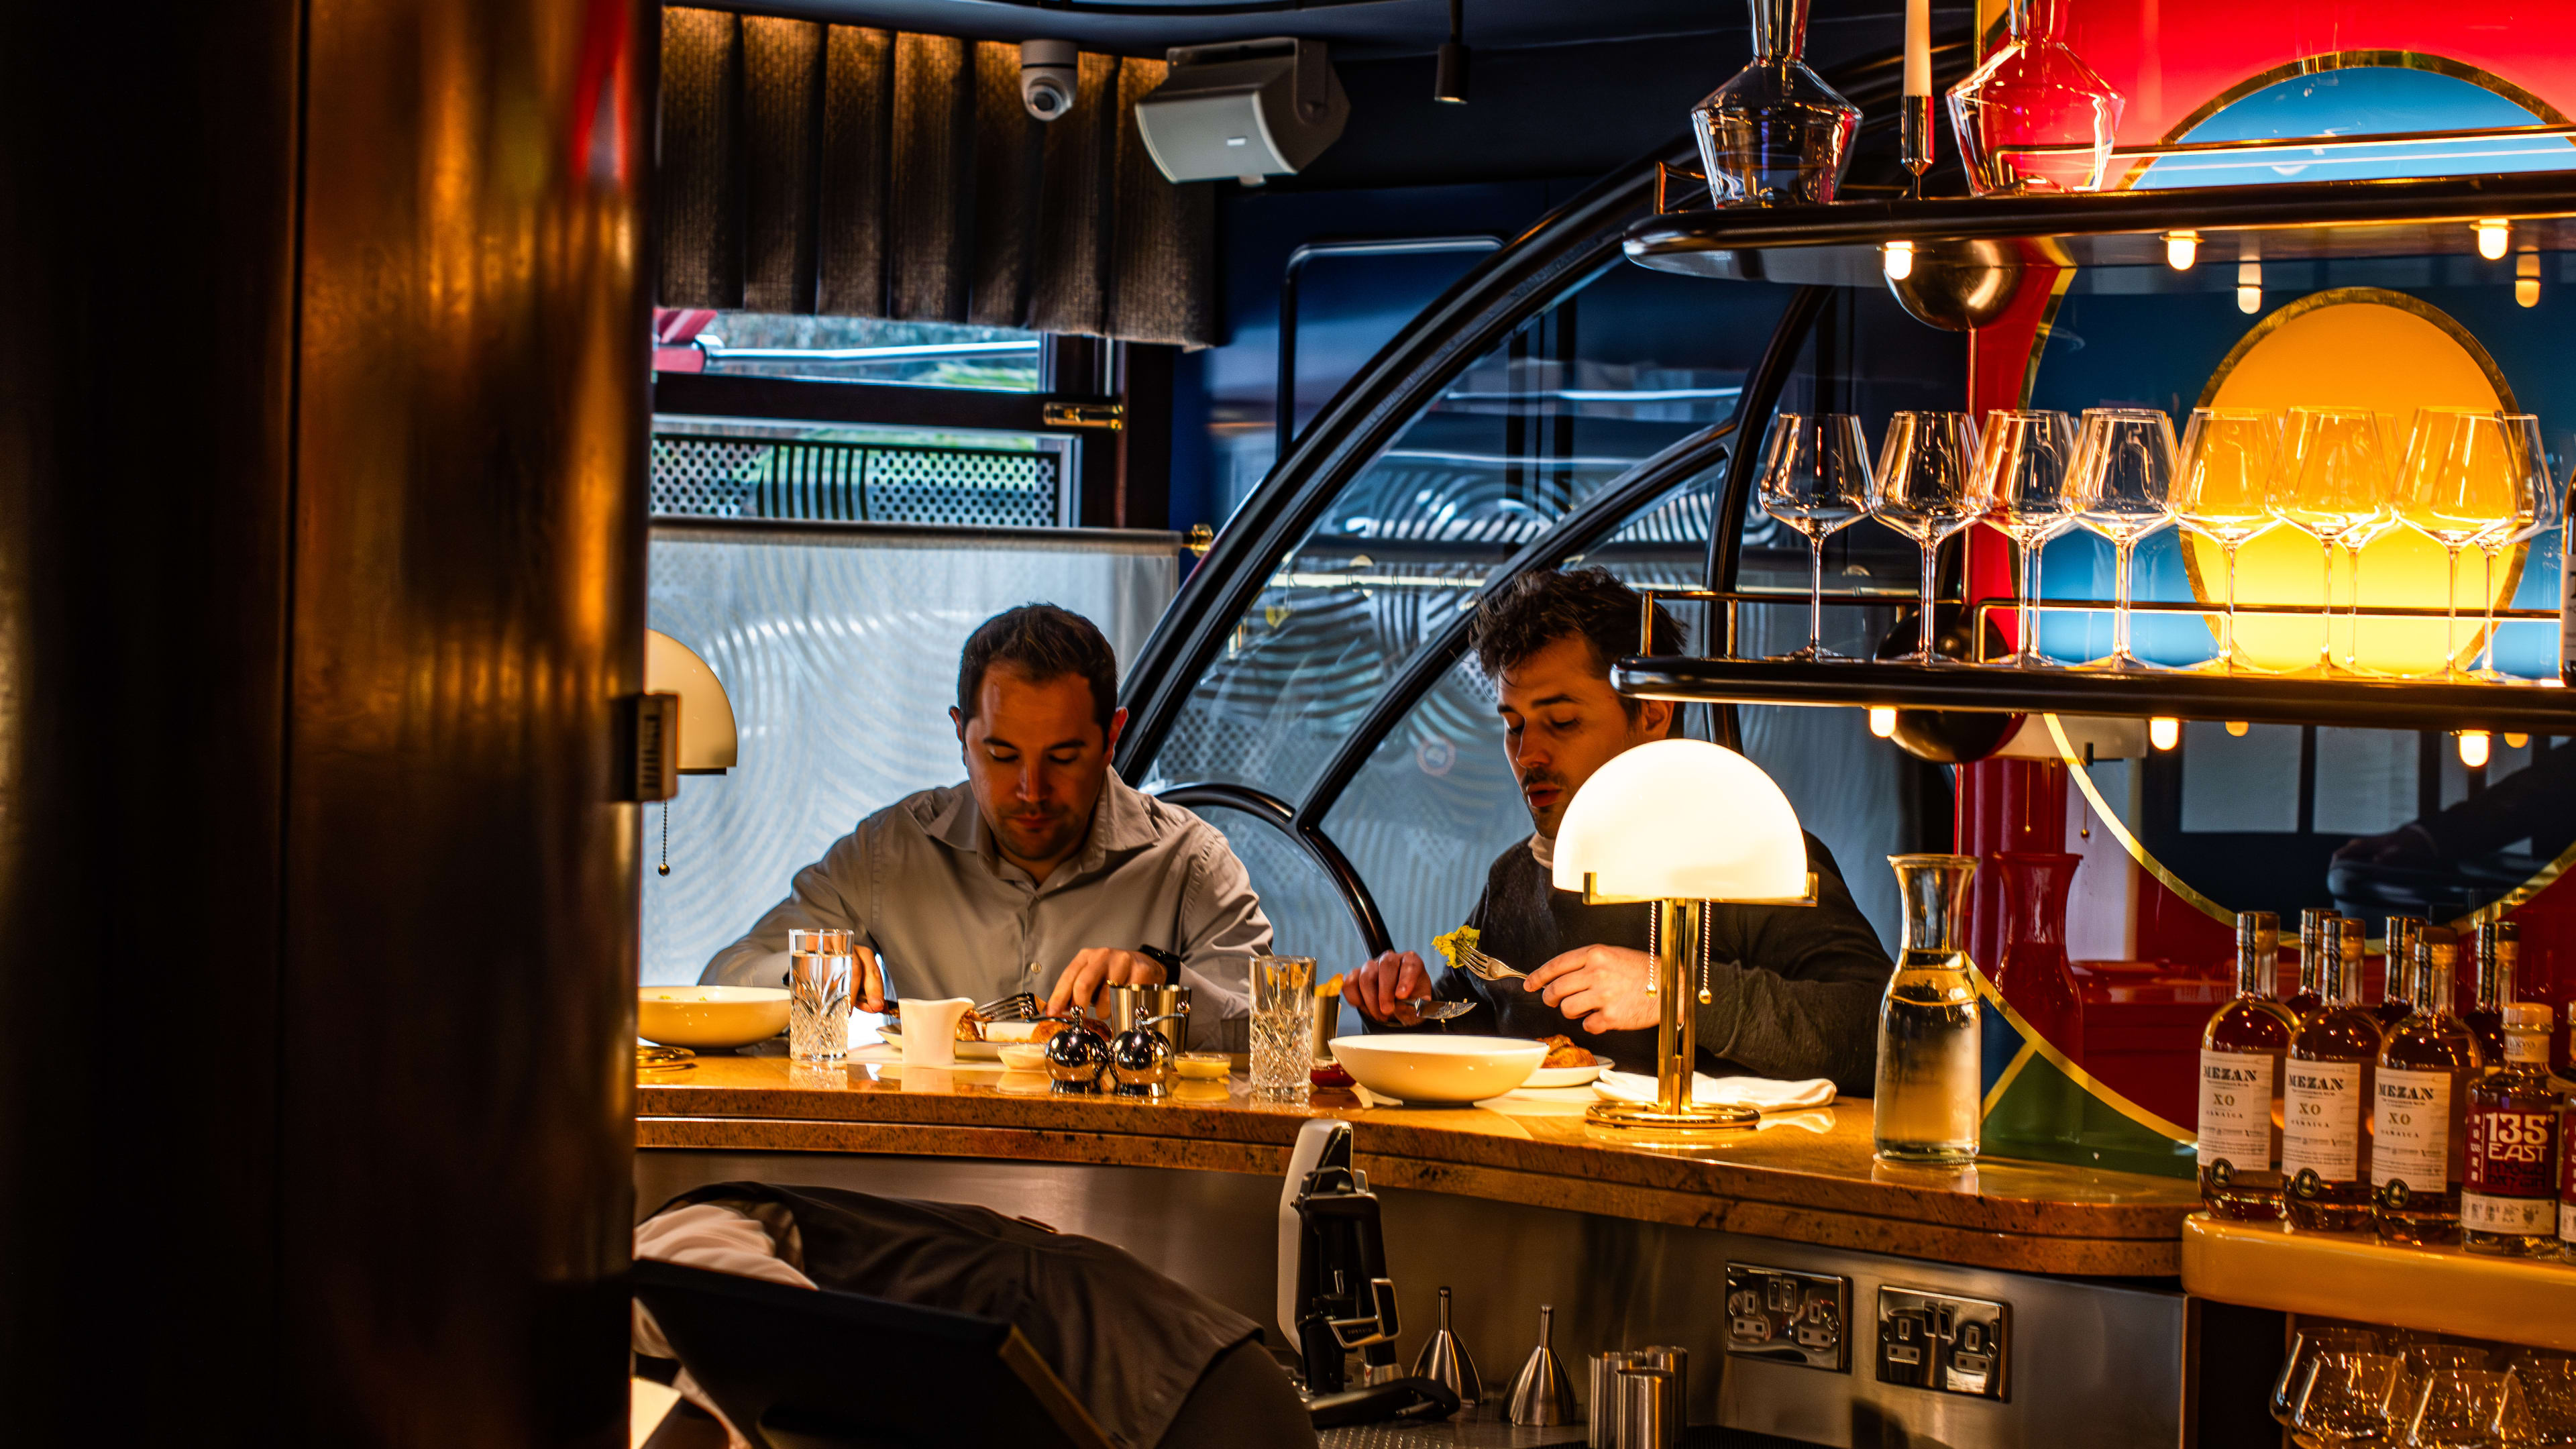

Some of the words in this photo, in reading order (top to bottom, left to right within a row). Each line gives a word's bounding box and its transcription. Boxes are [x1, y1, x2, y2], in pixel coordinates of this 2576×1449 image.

[2203, 1065, 2257, 1082] MEZAN
[2288, 1073, 2345, 1091] MEZAN
[2213, 1093, 2235, 1106] XO
[2377, 1081, 2434, 1101] MEZAN
[2298, 1102, 2321, 1116] XO
[2388, 1112, 2411, 1126] XO
[2487, 1142, 2547, 1163] EAST
